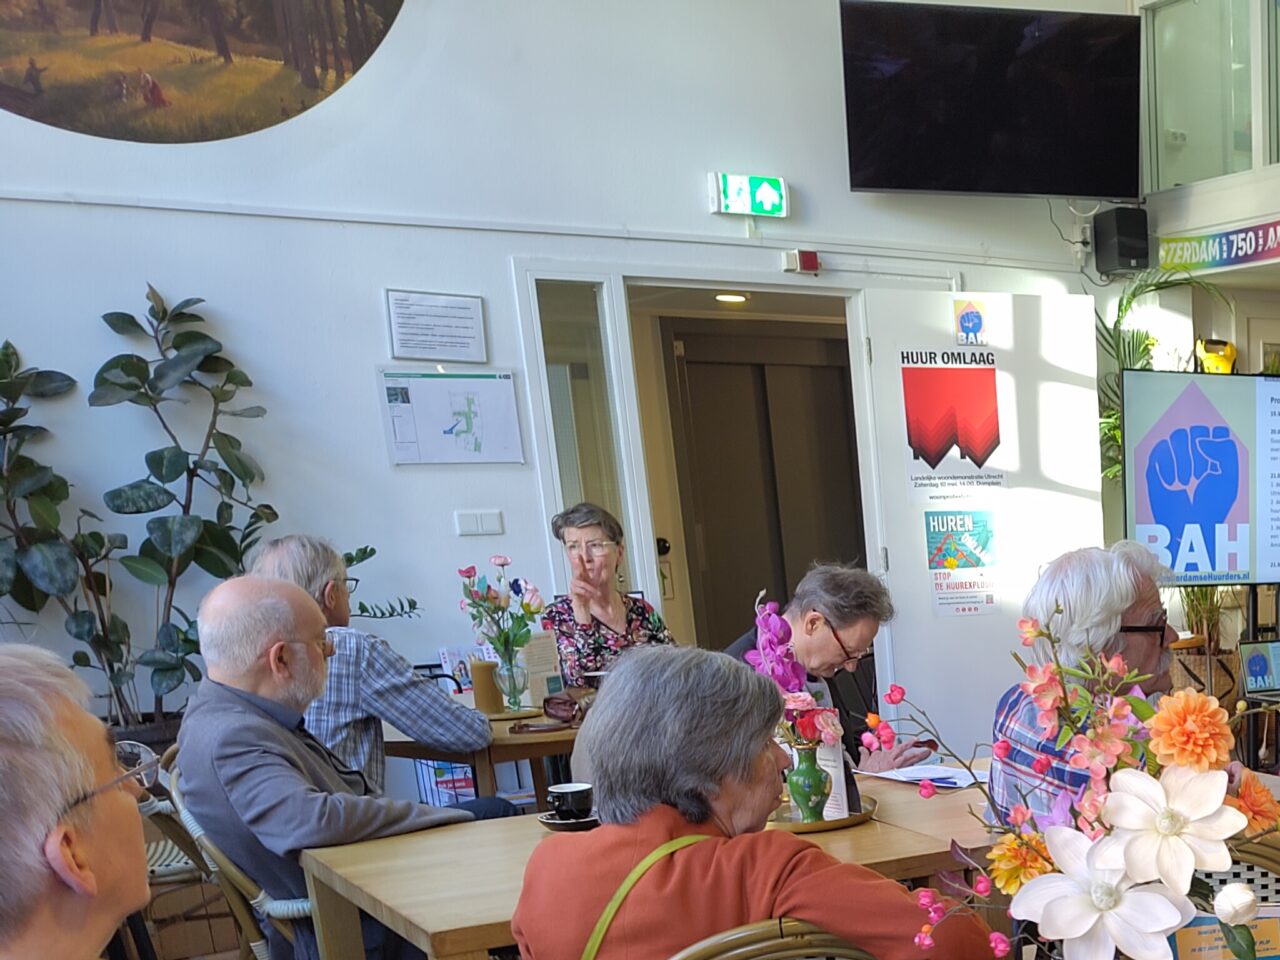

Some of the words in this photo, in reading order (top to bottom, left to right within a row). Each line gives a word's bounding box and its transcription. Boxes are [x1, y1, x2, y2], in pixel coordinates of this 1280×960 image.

[1230, 231, 1255, 259] 750
[900, 351, 937, 365] HUUR
[941, 352, 995, 365] OMLAAG
[929, 514, 974, 532] HUREN
[1136, 523, 1249, 572] BAH
[934, 572, 951, 581] STOP
[935, 582, 943, 591] DE
[946, 581, 993, 590] HUUREXPLO
[1248, 675, 1273, 688] BAH
